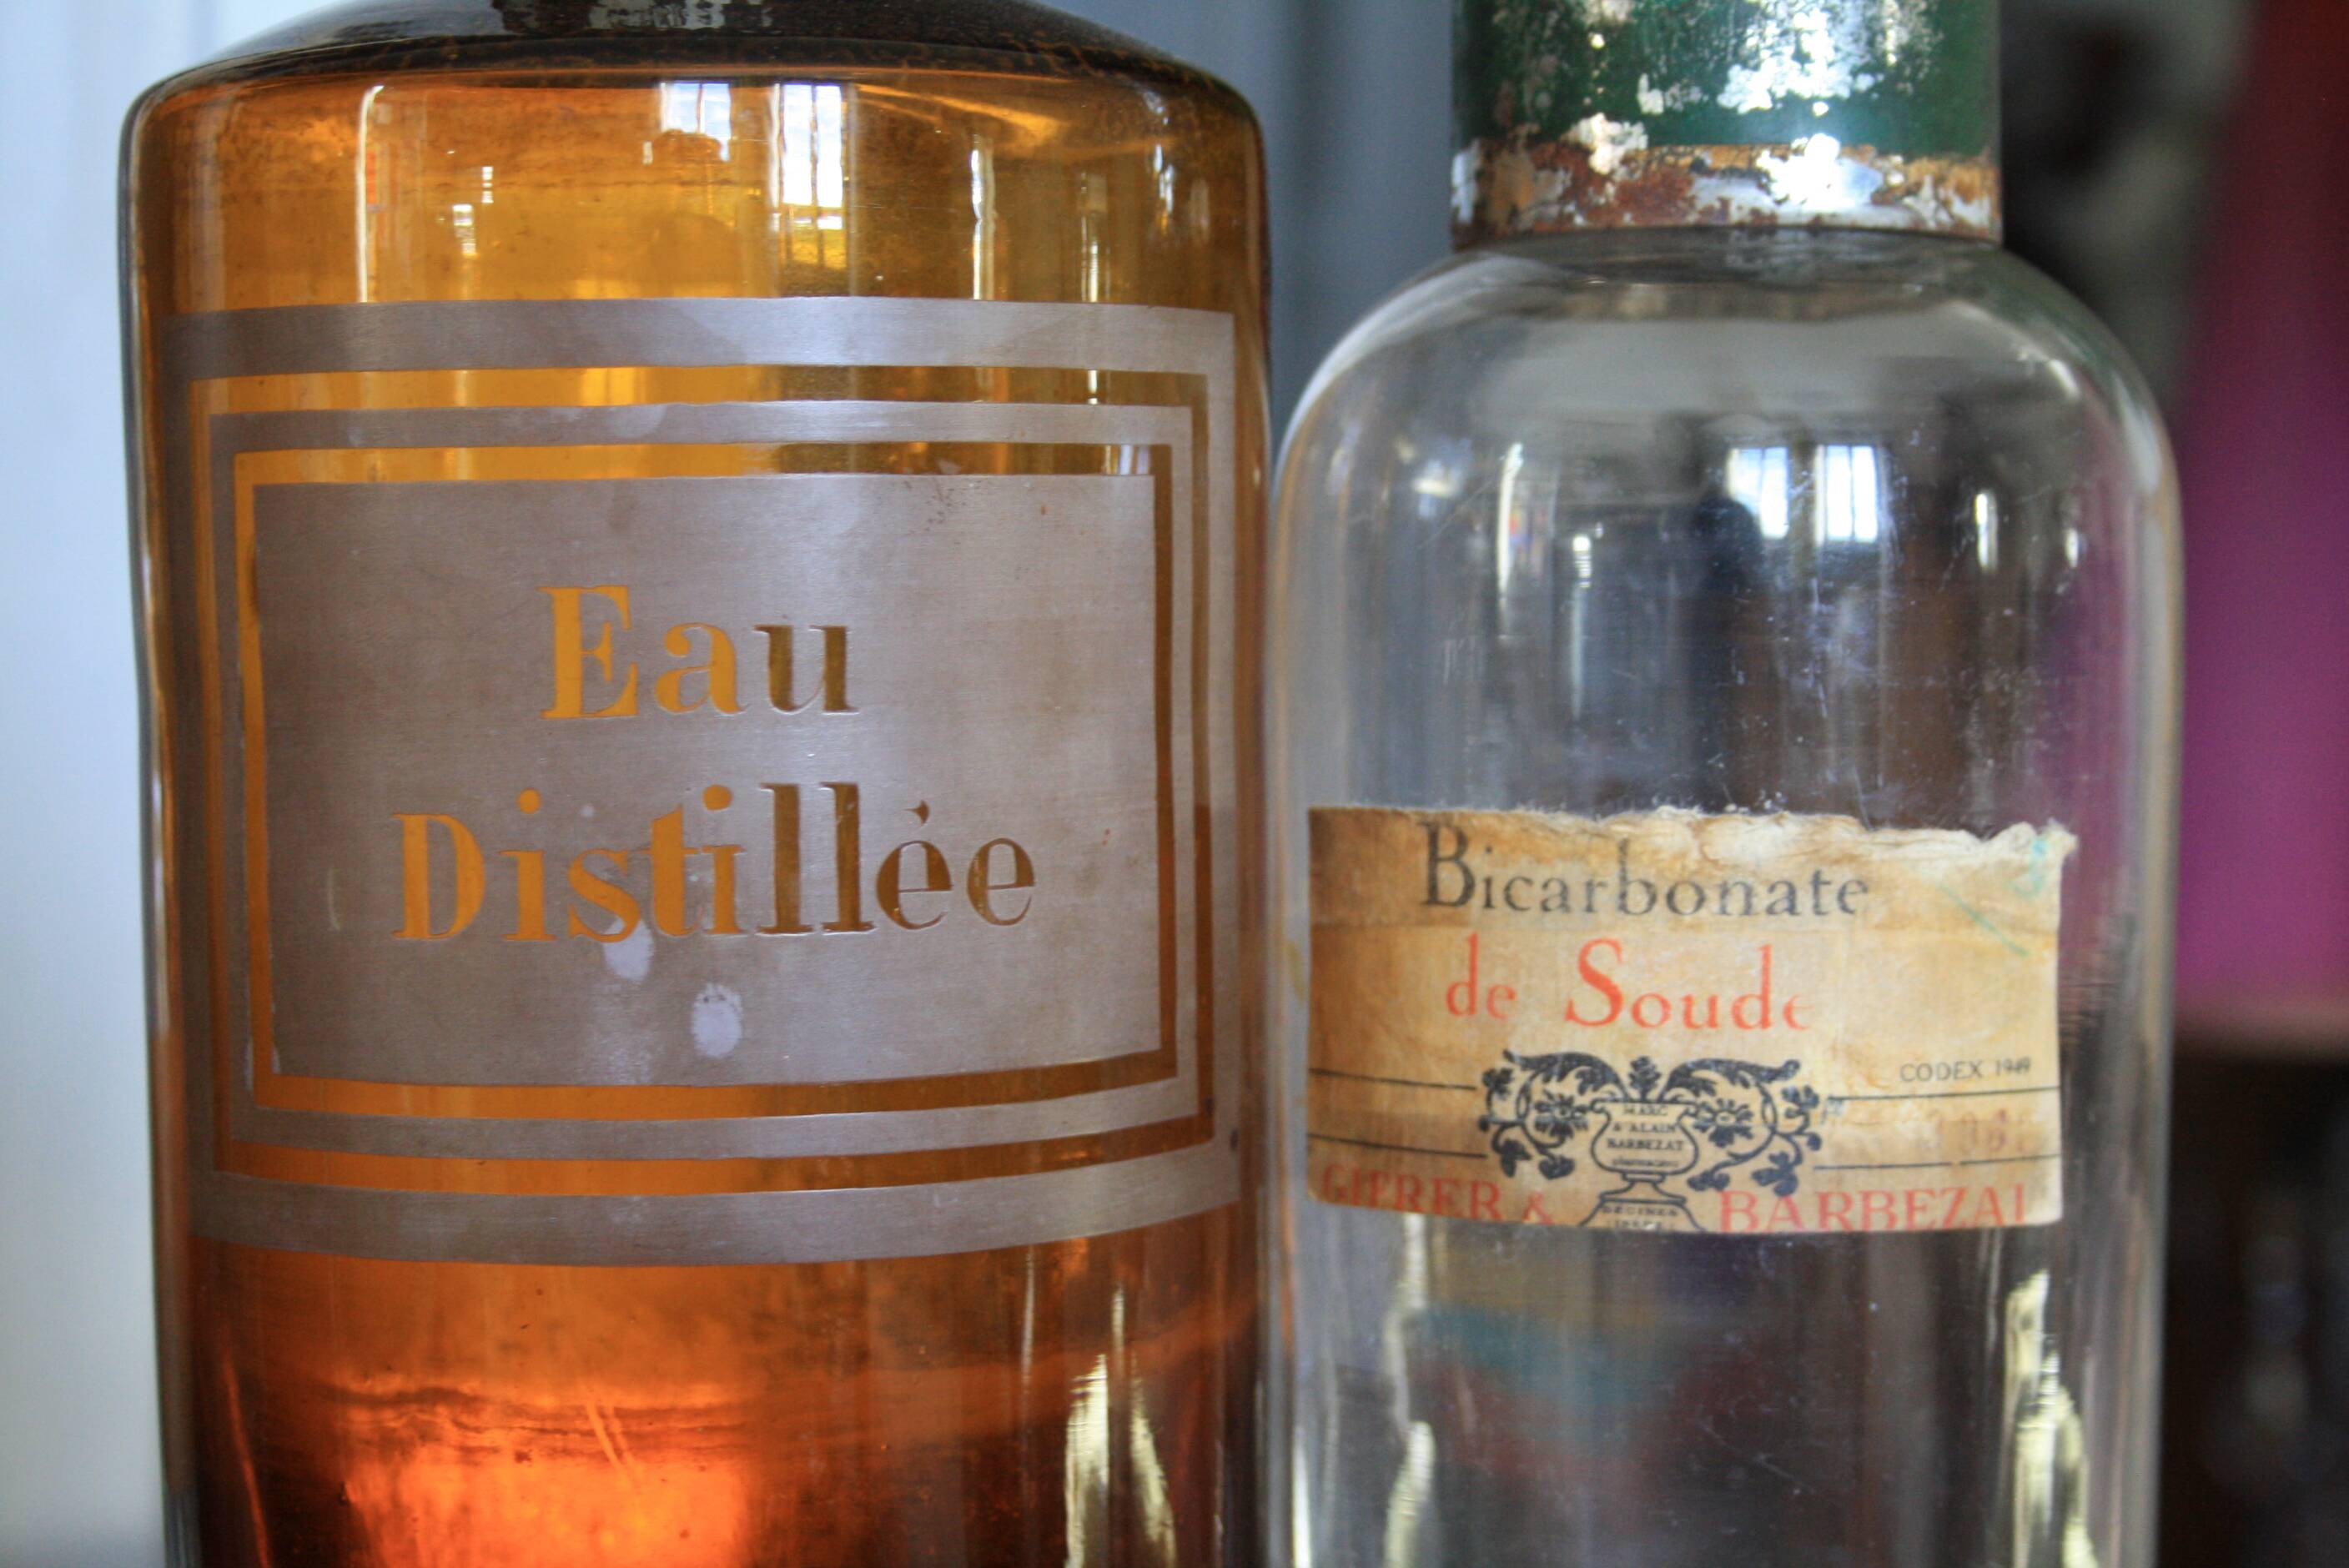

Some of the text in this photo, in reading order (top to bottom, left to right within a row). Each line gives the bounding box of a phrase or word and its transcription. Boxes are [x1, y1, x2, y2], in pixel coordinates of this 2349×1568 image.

[538, 585, 861, 719] Eau
[1422, 822, 1869, 917] Bicarbonate
[1446, 932, 1813, 1031] de Soude
[1899, 1060, 1984, 1083] CODEX
[1607, 1138, 1684, 1151] BARBEZAT
